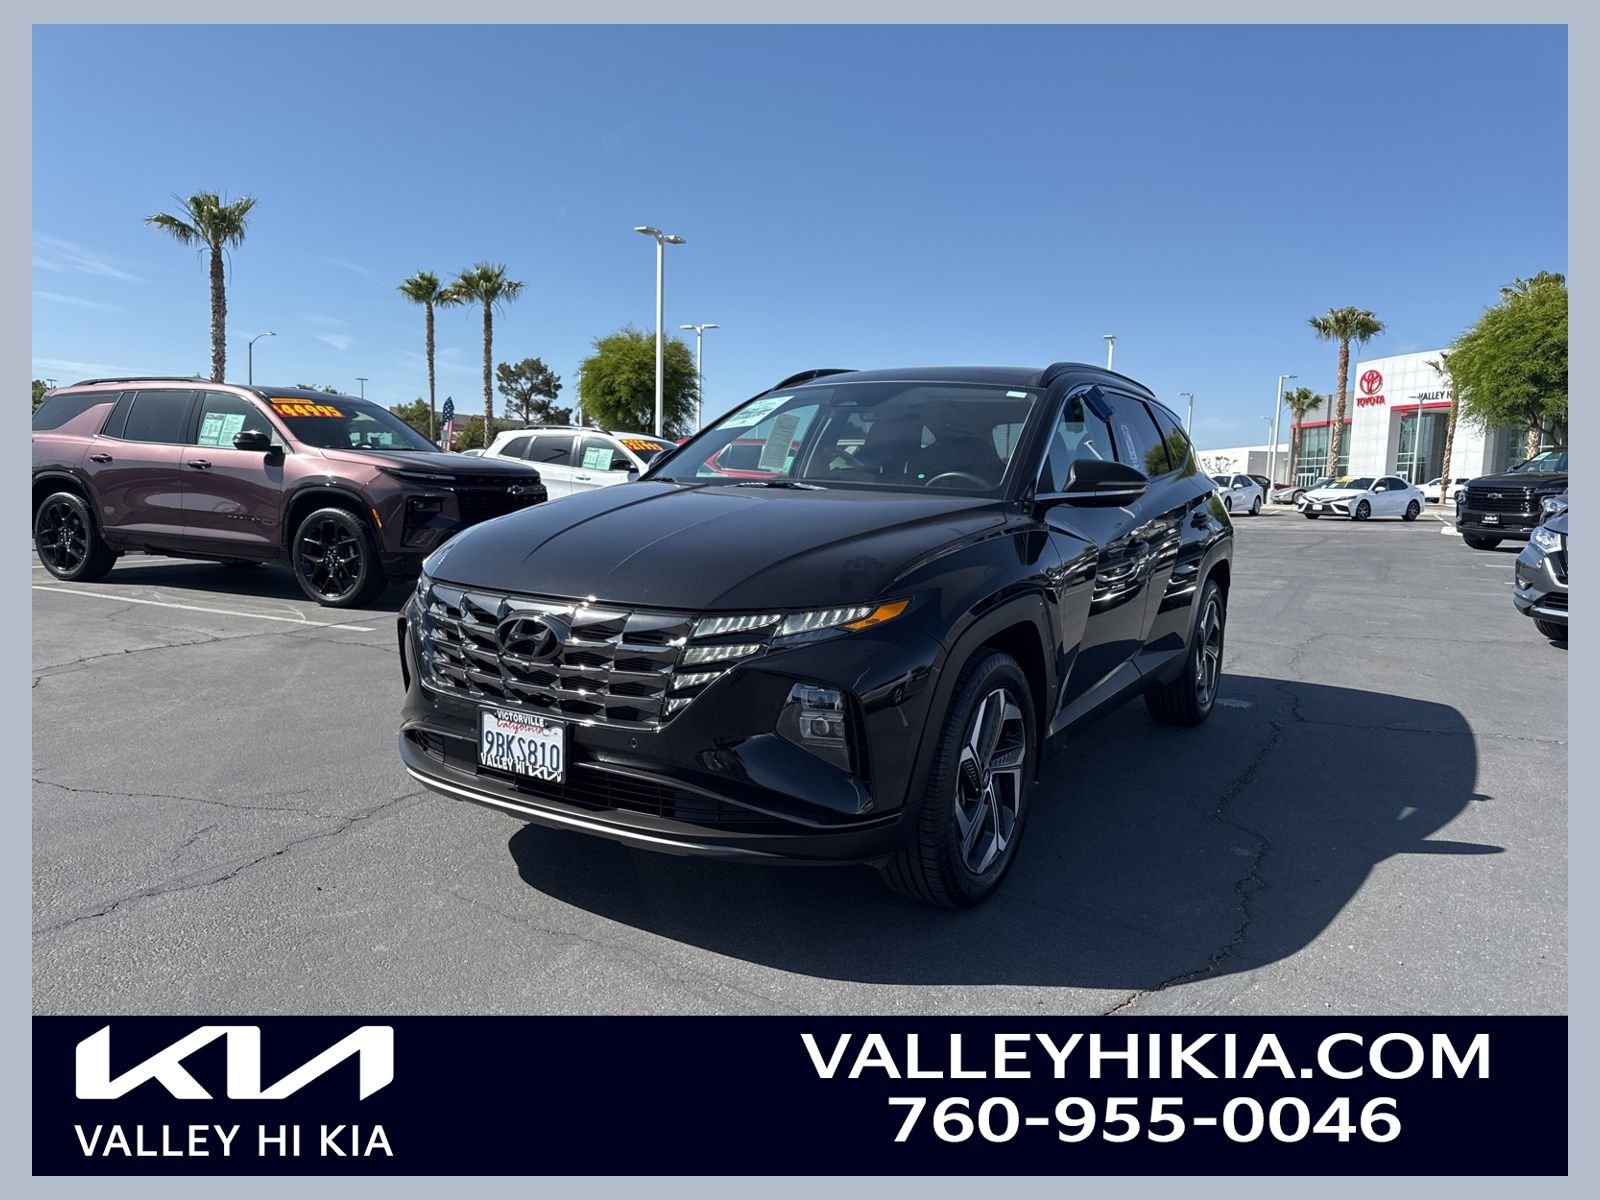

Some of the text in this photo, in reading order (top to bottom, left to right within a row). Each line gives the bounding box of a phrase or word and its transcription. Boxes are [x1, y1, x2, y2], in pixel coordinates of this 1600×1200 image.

[1356, 395, 1386, 408] TOYOTA
[1418, 391, 1445, 400] VALLEY
[496, 709, 545, 728] VICTORVILLE
[485, 730, 560, 772] 9BKS810
[481, 752, 513, 772] VALLEY
[515, 761, 526, 775] HI
